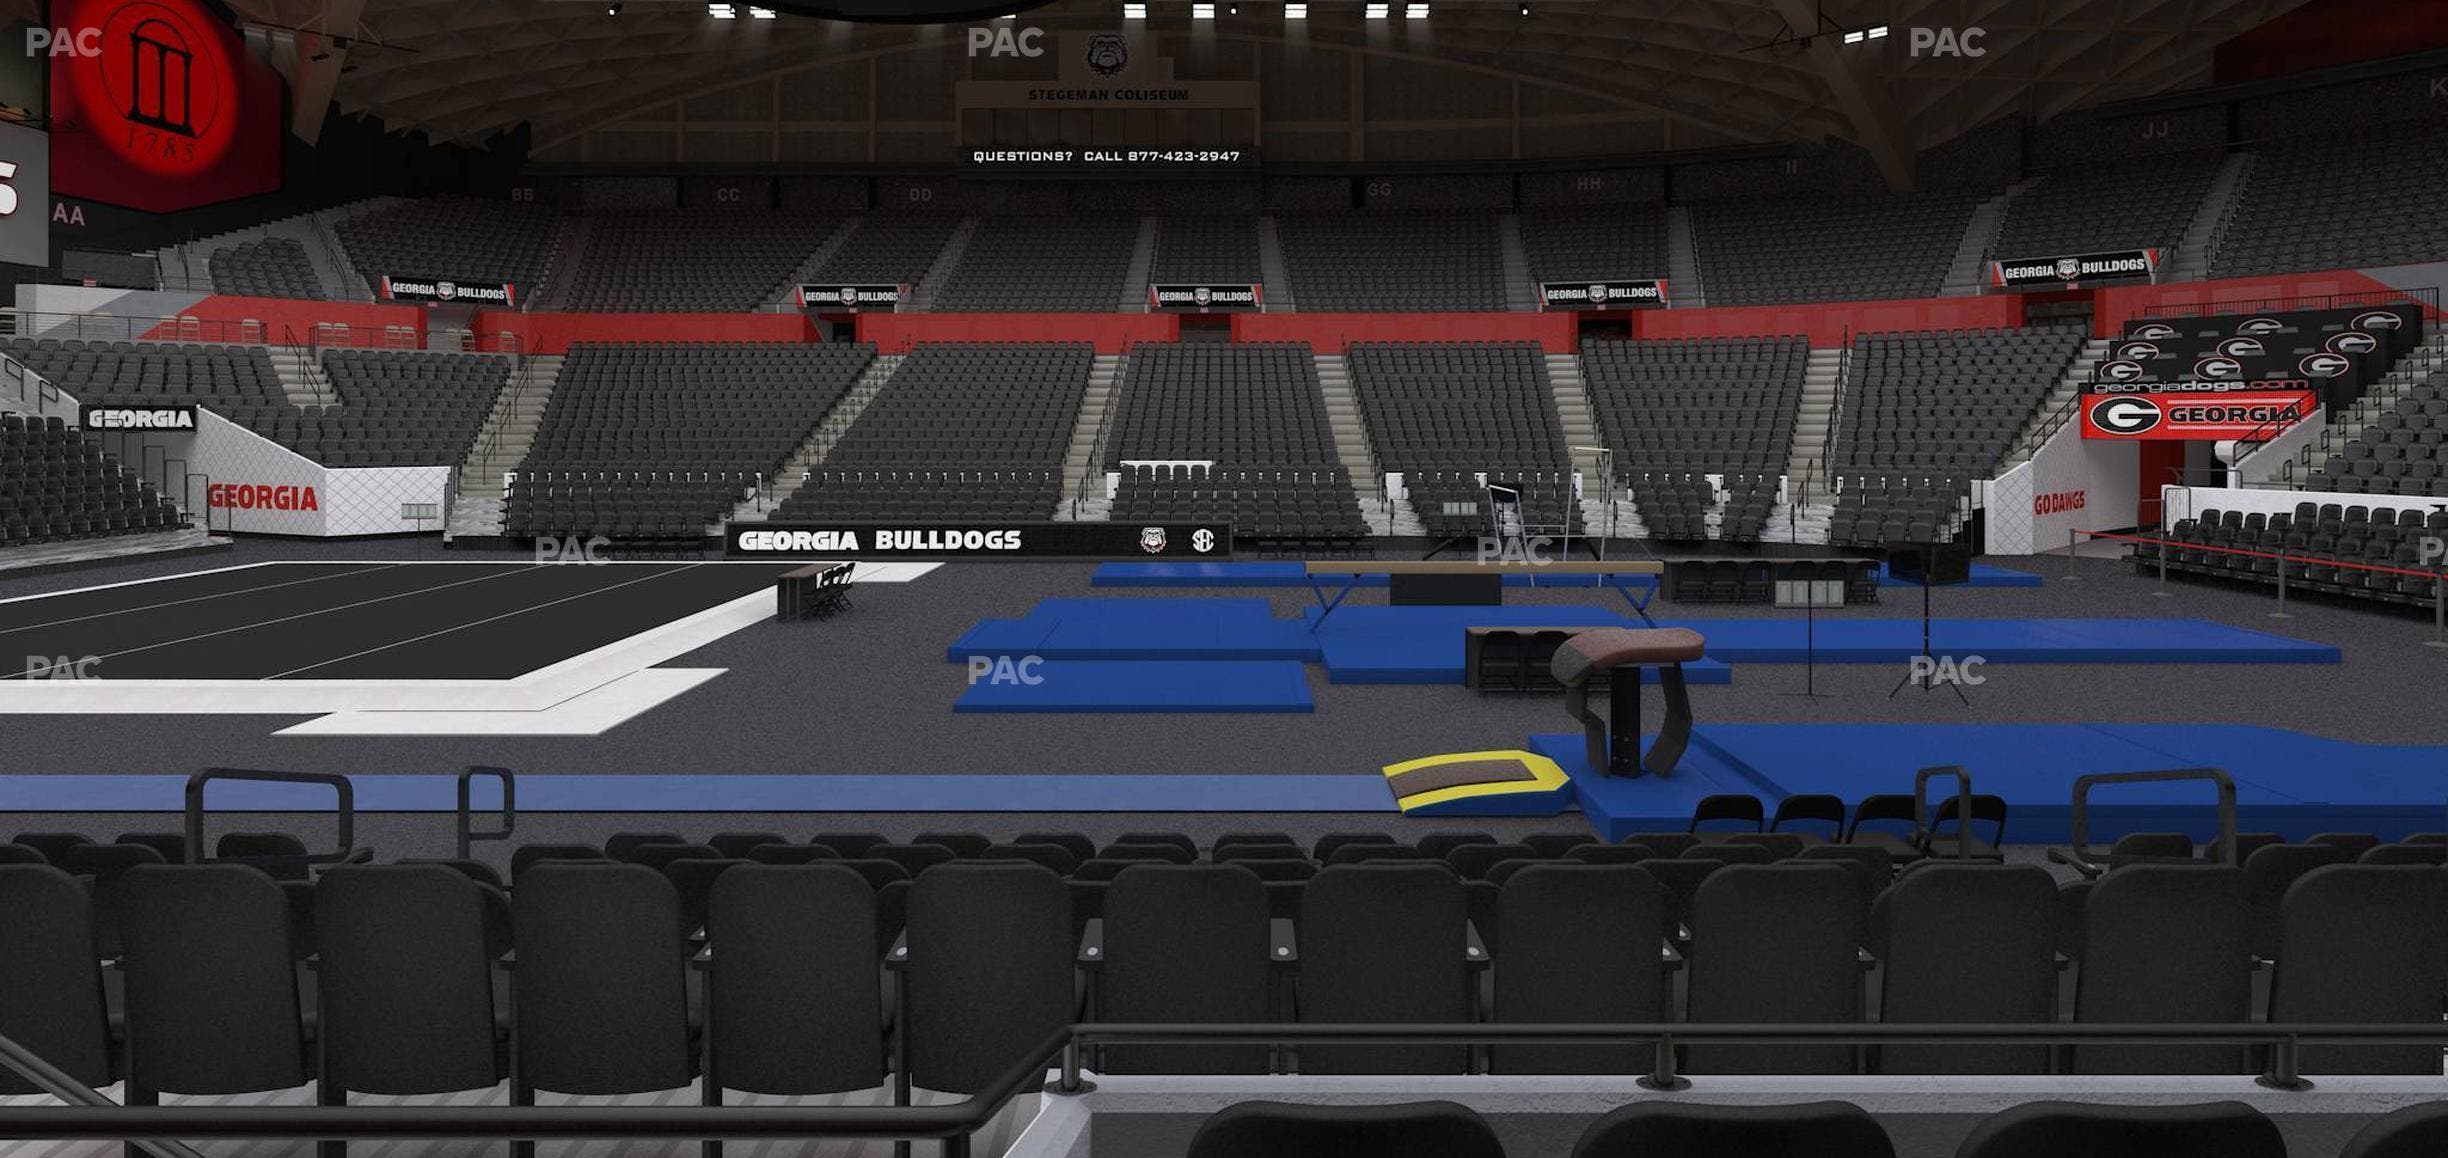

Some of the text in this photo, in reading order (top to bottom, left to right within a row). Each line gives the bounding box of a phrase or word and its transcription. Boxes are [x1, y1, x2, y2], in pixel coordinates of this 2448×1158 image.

[1027, 89, 1189, 101] STEGEMAN COLISEUM
[2142, 120, 2168, 139] JJ
[127, 128, 196, 162] 1785
[972, 150, 1241, 163] QUESTIONS? CALL 877-423-2947
[1367, 182, 1392, 196] GG
[1577, 176, 1602, 190] HH
[511, 187, 535, 201] BB
[717, 187, 740, 201] CC
[909, 187, 933, 201] DD
[52, 203, 87, 227] AA
[2005, 258, 2146, 279] GEORGIA BULLDOGS
[392, 282, 505, 300] GEORGIA BULLDOGS
[805, 291, 899, 302] GEORGIA BULLDOGS
[1159, 291, 1253, 302] GEORGIA BULLDOGS
[1547, 287, 1658, 300] GEORGIA BULLDOGS
[2094, 379, 2310, 394] georgiadogs.com
[88, 409, 194, 428] GEORGIA
[2168, 405, 2301, 424] GEORGIA
[207, 483, 319, 511] GEORGIA
[2034, 490, 2085, 515] GO DAWGS
[738, 530, 1022, 551] GEORGIA BULLDOGS
[1191, 528, 1215, 552] SEC
